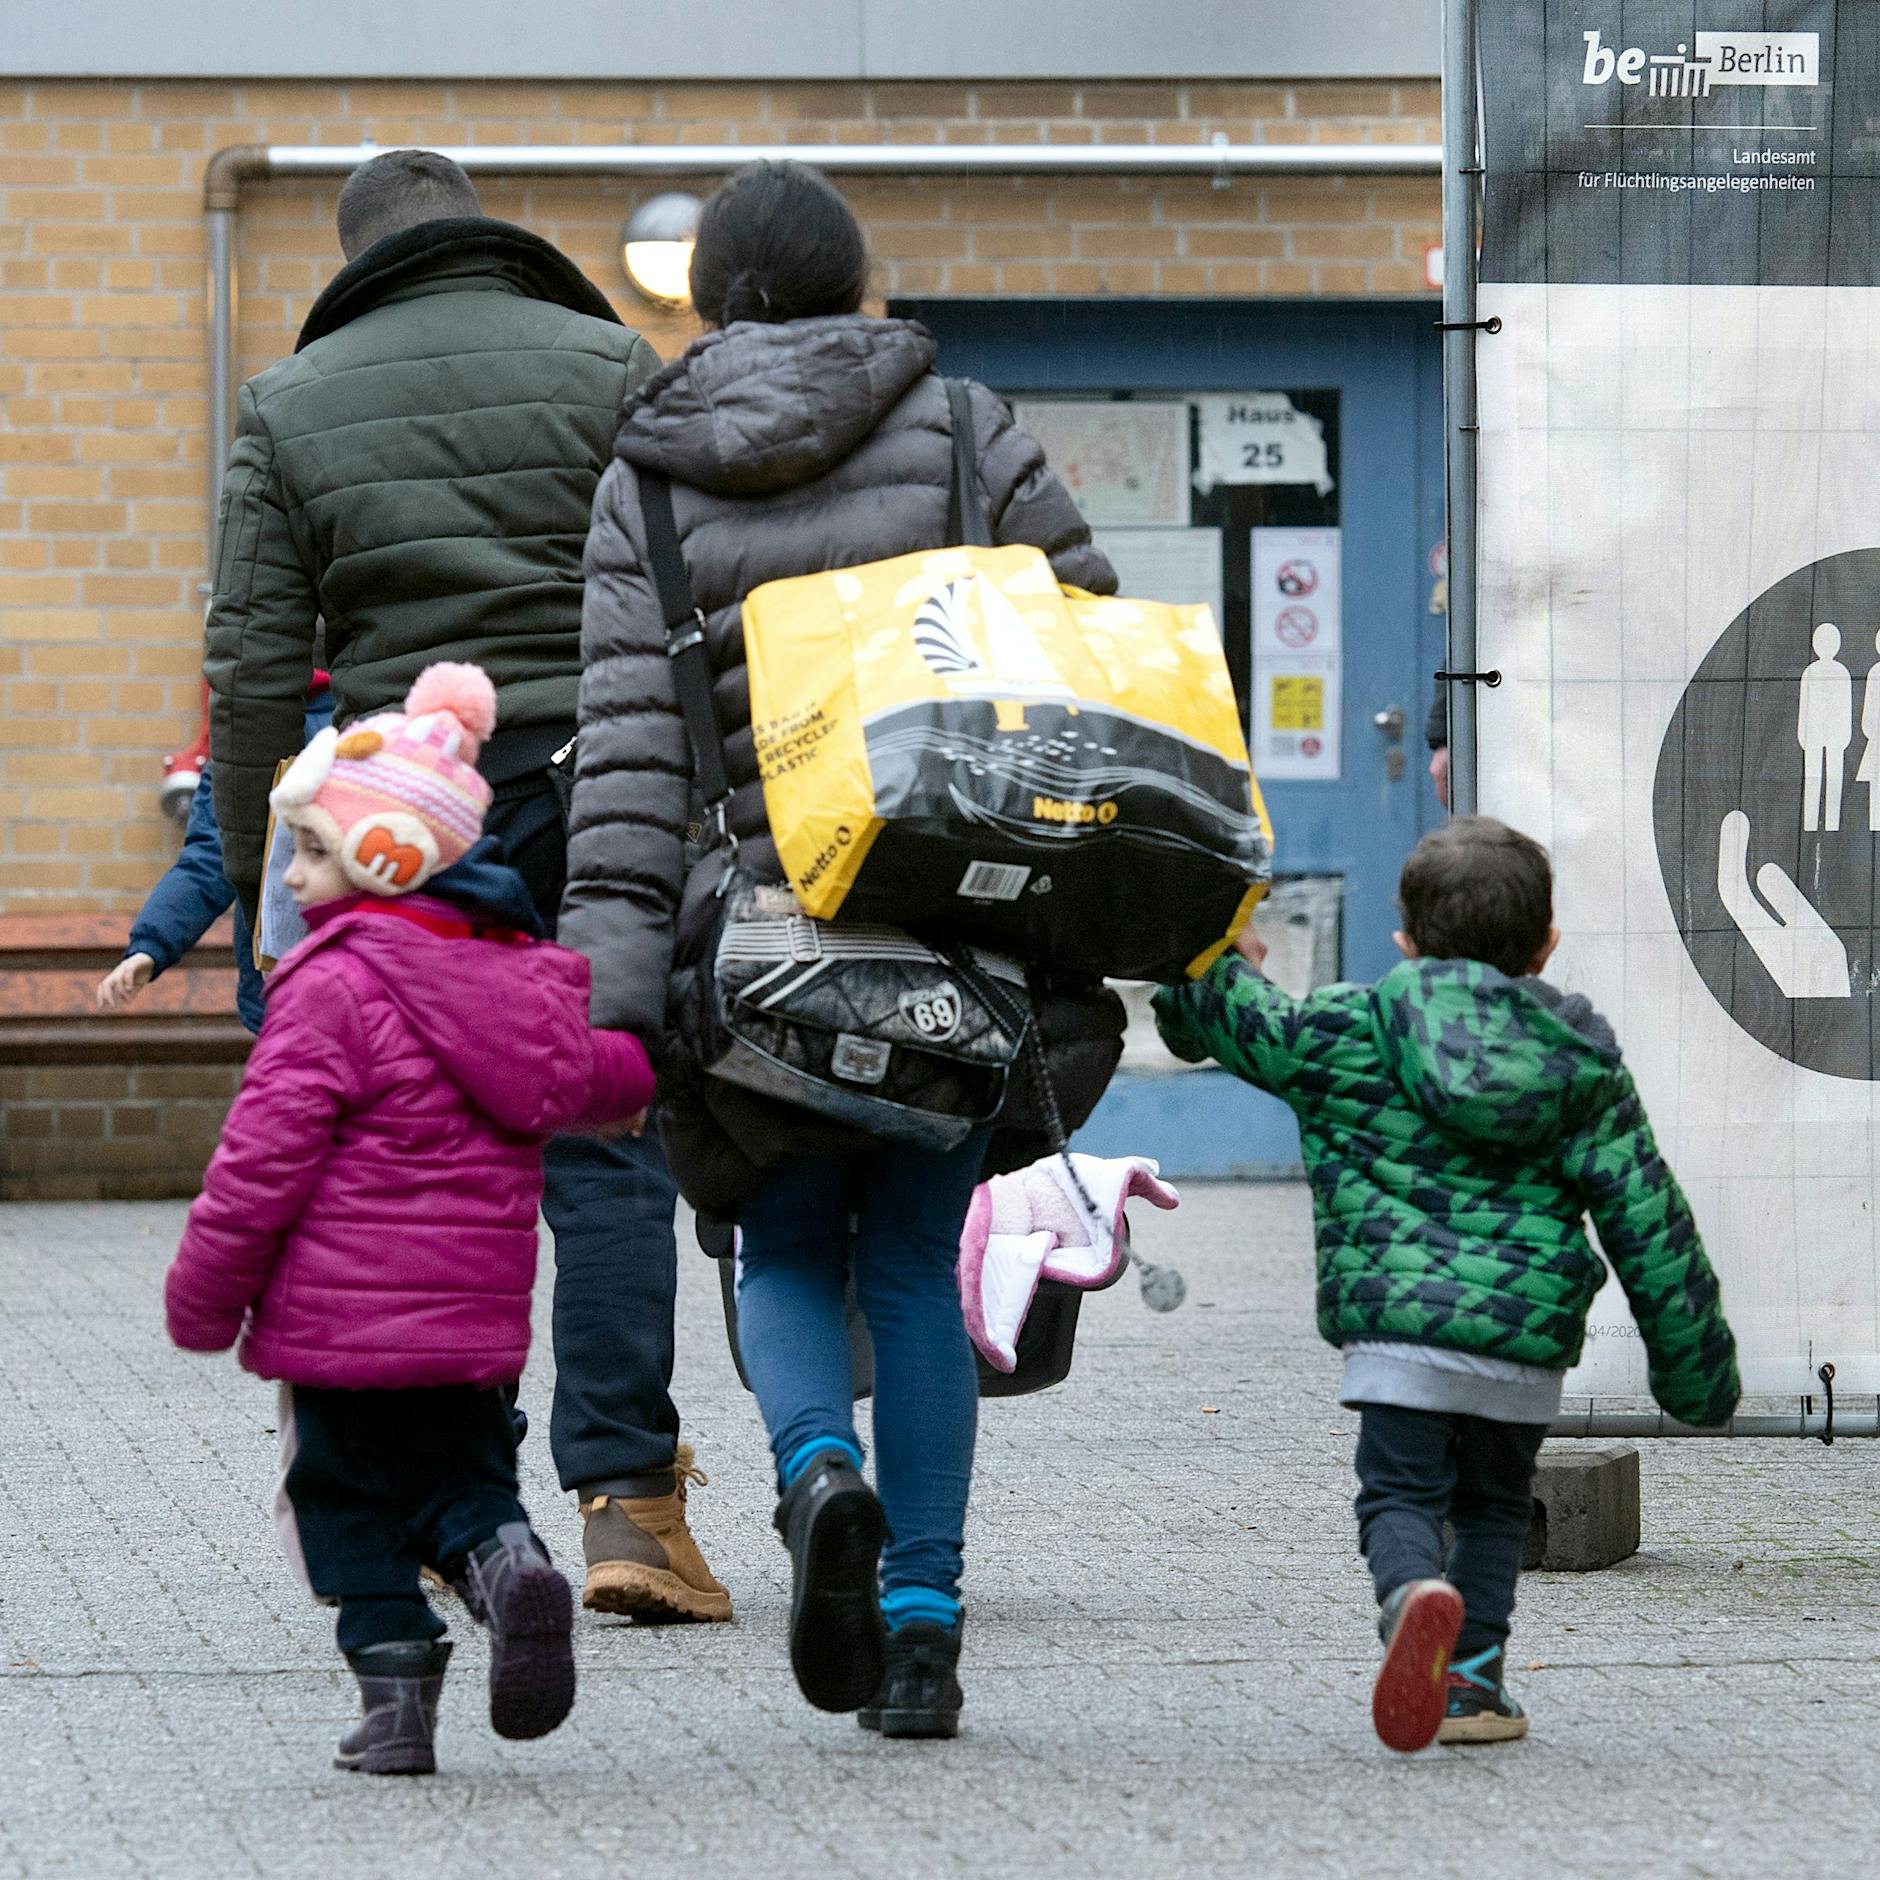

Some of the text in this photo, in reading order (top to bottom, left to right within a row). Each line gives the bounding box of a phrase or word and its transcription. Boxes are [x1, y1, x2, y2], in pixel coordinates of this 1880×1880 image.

[1582, 30, 1806, 85] be Berlin
[1732, 148, 1816, 166] Landesamt
[1577, 172, 1815, 192] für Flüchtlingsangelegenheiten
[1227, 404, 1296, 423] Haus
[1242, 442, 1284, 468] 25
[1032, 795, 1097, 824] Netto
[799, 844, 838, 893] Netto
[913, 997, 955, 1033] 69
